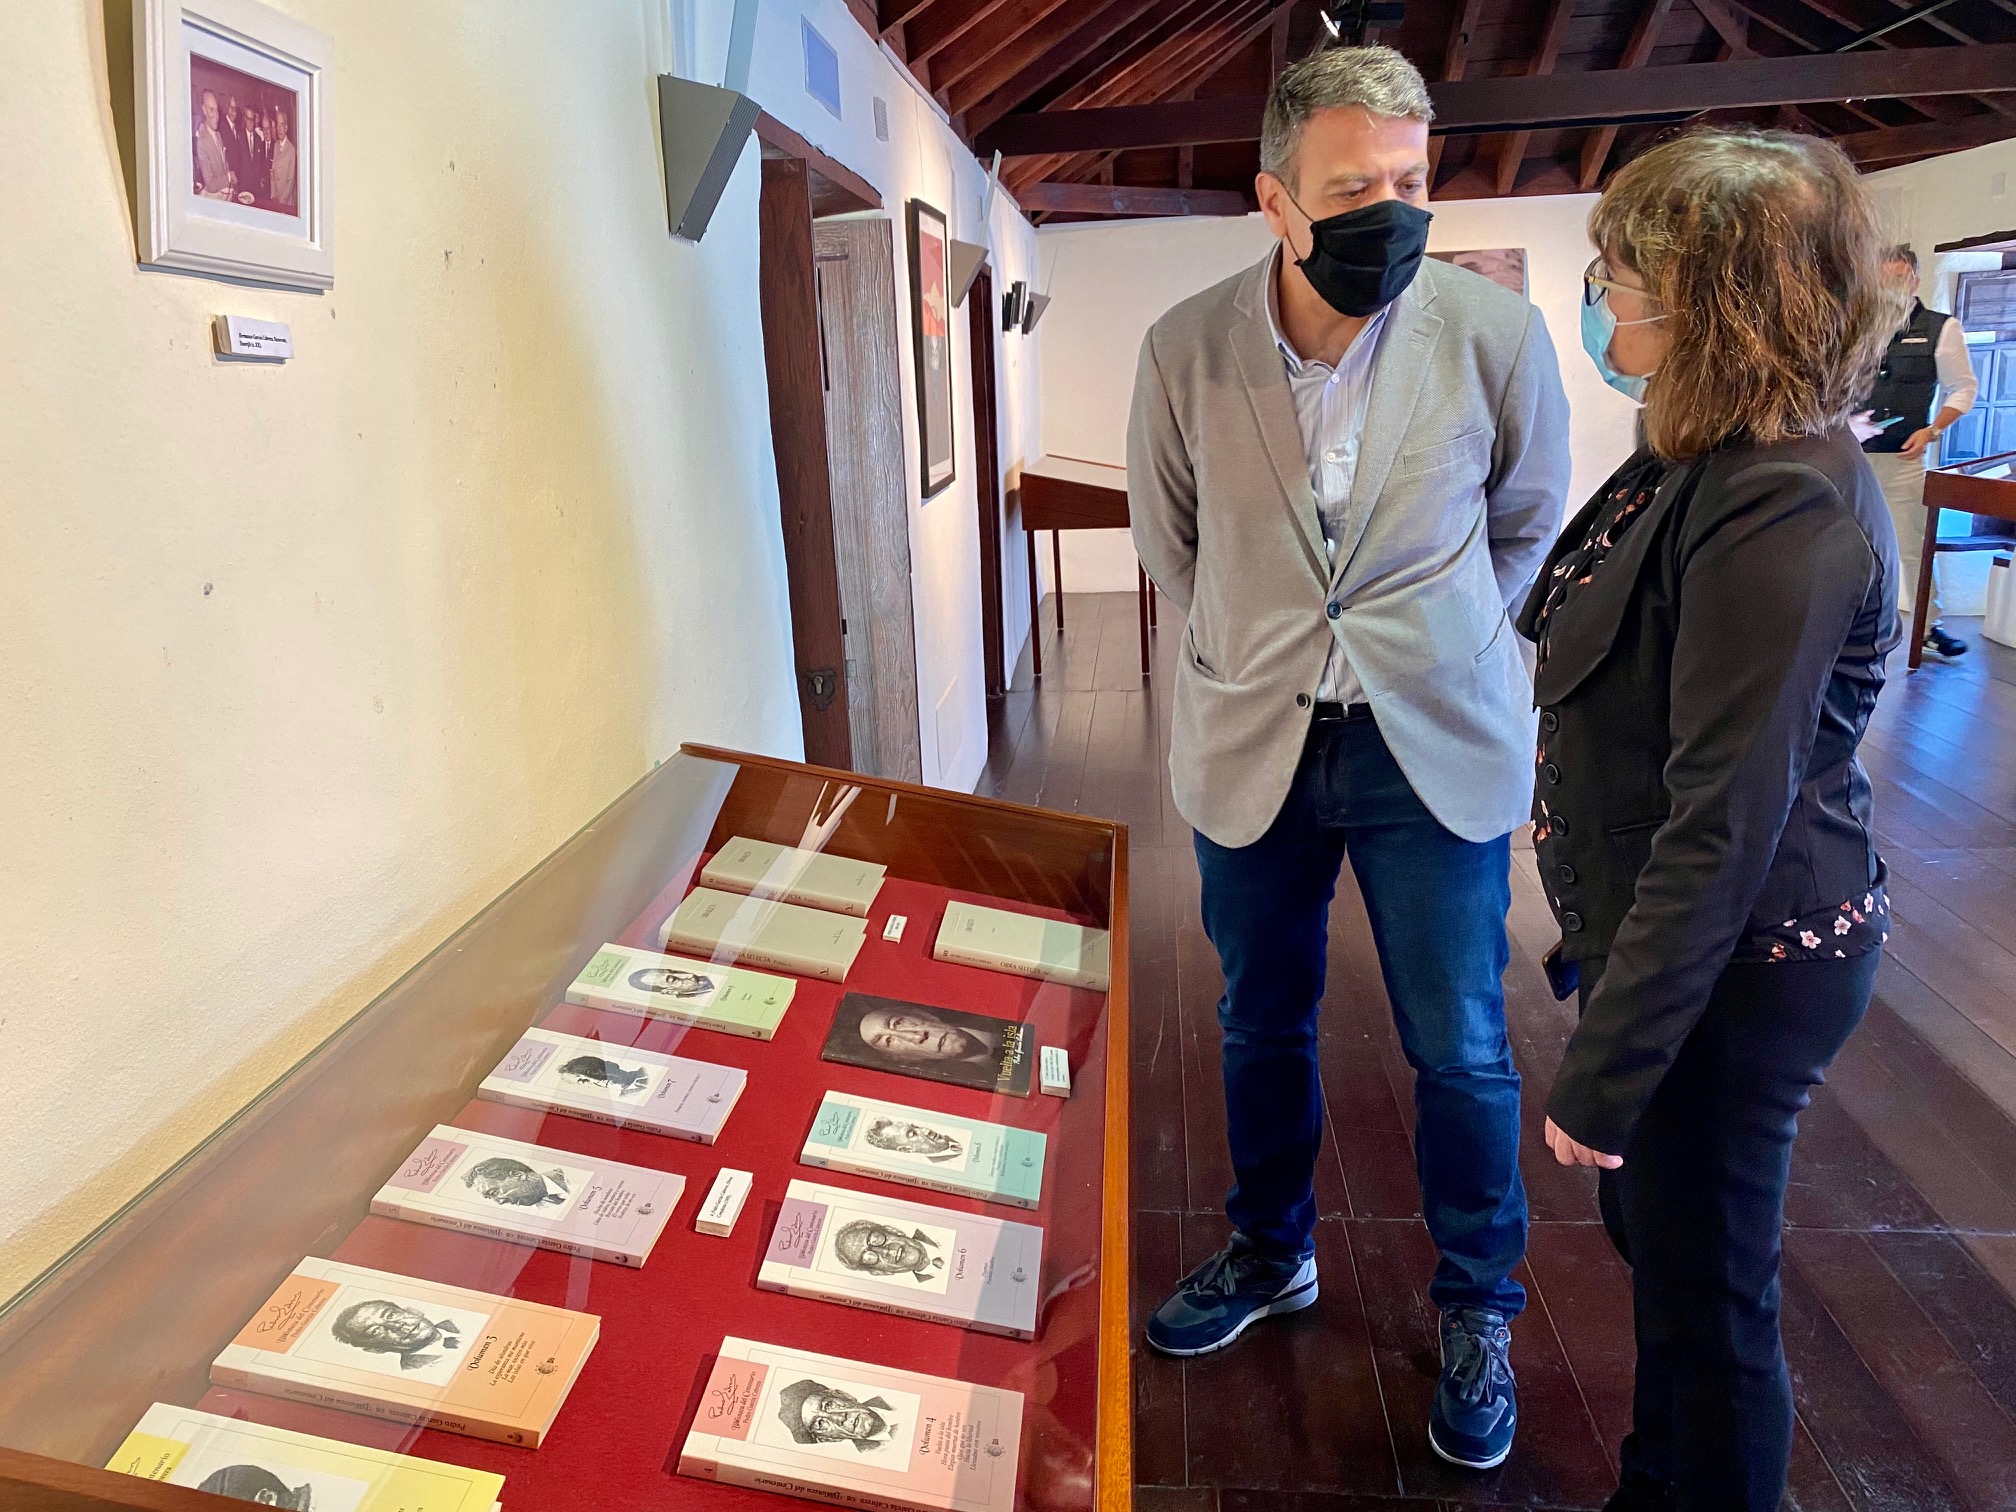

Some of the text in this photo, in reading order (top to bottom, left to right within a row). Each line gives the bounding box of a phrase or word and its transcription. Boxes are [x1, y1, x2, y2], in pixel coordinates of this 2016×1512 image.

[1000, 961, 1041, 974] OBRA SELECTA
[1003, 1025, 1017, 1039] isla
[997, 1056, 1012, 1080] Vuelta
[578, 1190, 596, 1210] Volumen
[430, 1216, 462, 1227] Centenario
[541, 1239, 561, 1248] García
[562, 1244, 580, 1252] Pedro
[954, 1254, 965, 1280] Volumen
[301, 1288, 324, 1312] Centenario
[467, 1341, 490, 1370] Volumen
[494, 1358, 509, 1379] esperanza
[507, 1374, 516, 1383] Las
[512, 1364, 522, 1374] islas
[284, 1388, 322, 1400] Centenario
[731, 1405, 744, 1430] Biblioteca
[742, 1371, 755, 1397] Centenario
[388, 1409, 465, 1430] Pedro García Cabrera
[919, 1423, 931, 1455] Volumen
[947, 1453, 955, 1471] Elegías
[753, 1477, 792, 1490] Centenario
[805, 1486, 843, 1500] Biblioteca
[859, 1498, 888, 1509] Cabrera
